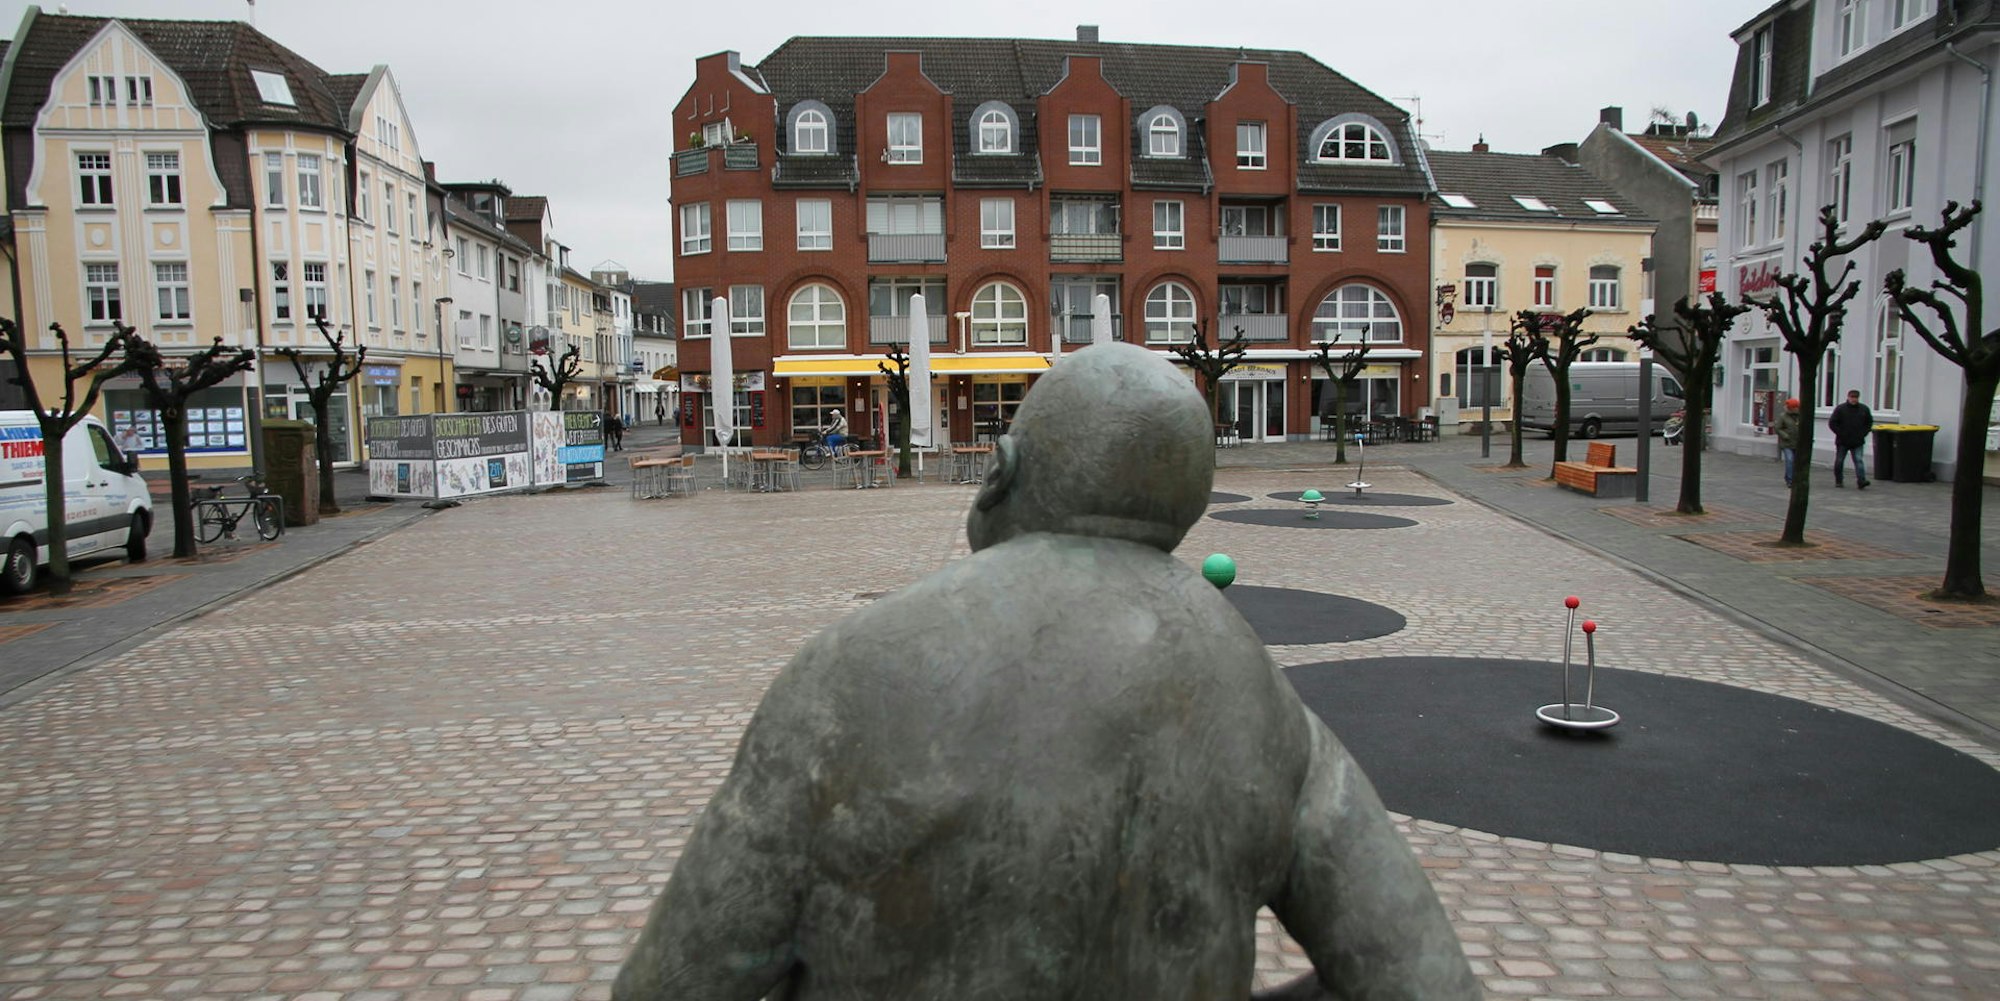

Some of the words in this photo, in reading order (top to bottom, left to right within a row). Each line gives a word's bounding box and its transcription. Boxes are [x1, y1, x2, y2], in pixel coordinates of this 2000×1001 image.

[401, 418, 410, 437] DES
[411, 418, 427, 437] GUTEN
[436, 416, 481, 437] BOTSCHAFTER
[482, 415, 496, 434] DES
[496, 414, 518, 433] GUTEN
[436, 437, 481, 458] GESCHMACKS
